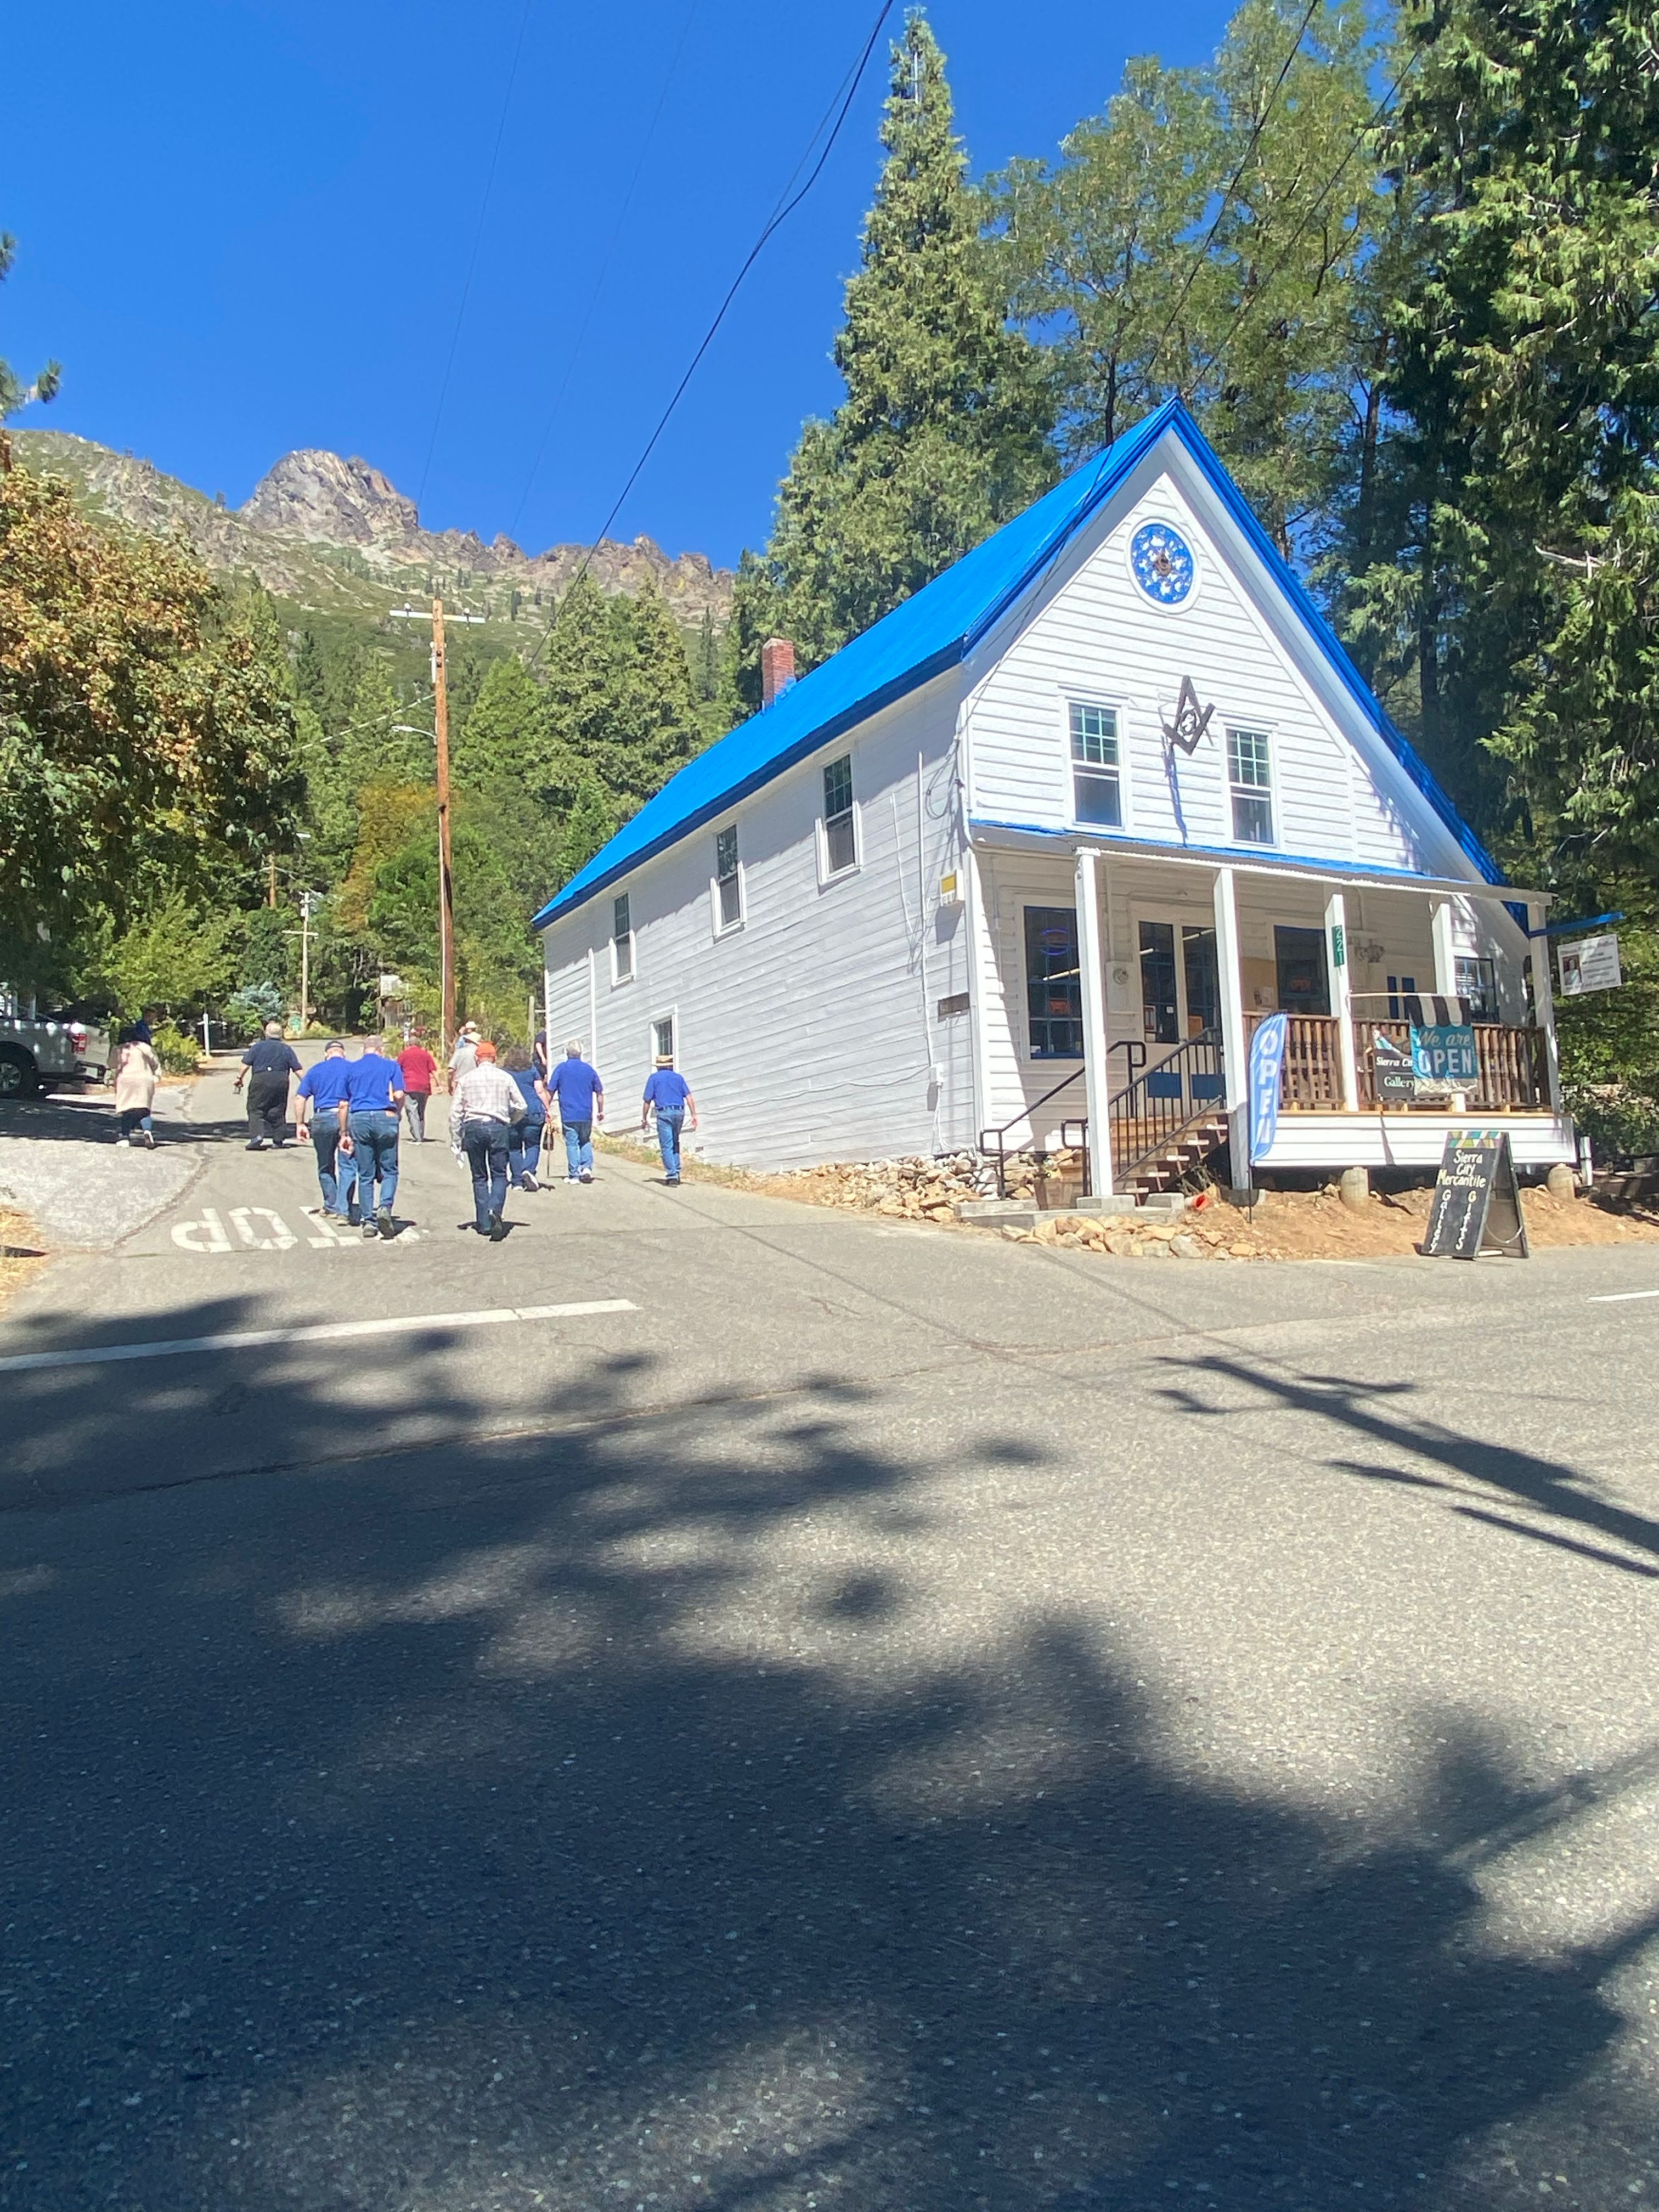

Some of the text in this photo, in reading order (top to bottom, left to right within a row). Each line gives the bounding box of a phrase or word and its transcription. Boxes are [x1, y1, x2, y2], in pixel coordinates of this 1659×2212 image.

[1419, 1030, 1471, 1047] We are
[1376, 1056, 1400, 1067] Sierra
[1418, 1048, 1472, 1074] OPEN
[1257, 1030, 1279, 1144] OPEN
[1384, 1076, 1414, 1091] Gallery
[1454, 1149, 1483, 1164] Sierra
[1457, 1163, 1476, 1176] City
[1436, 1169, 1487, 1188] Mercantile
